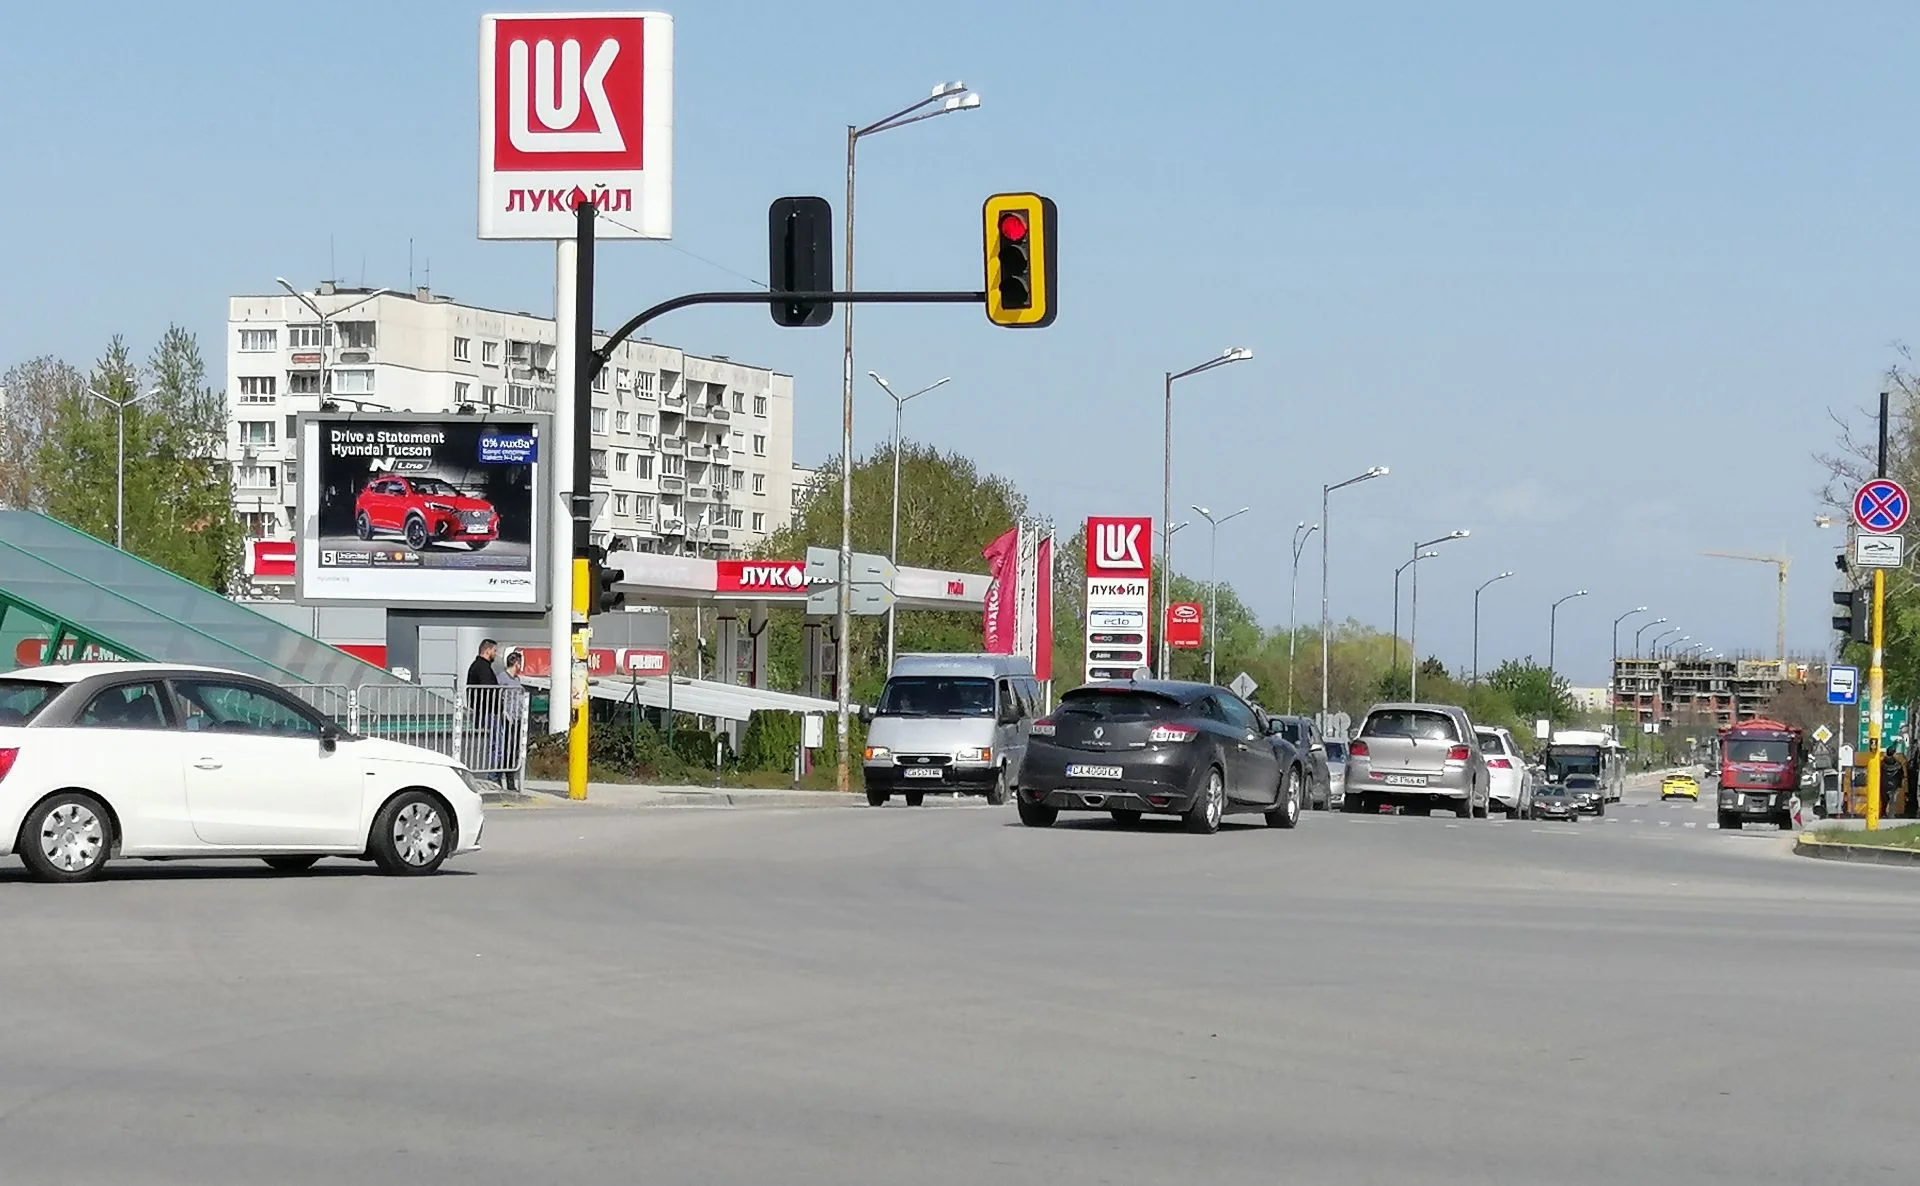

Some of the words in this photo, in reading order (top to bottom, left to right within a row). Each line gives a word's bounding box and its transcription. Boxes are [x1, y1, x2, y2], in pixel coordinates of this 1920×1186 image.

[331, 429, 364, 443] Drive
[366, 432, 375, 443] a
[377, 431, 445, 444] Statement
[482, 438, 498, 448] 0%
[331, 443, 384, 458] Hyundai
[386, 444, 432, 456] Tucson
[324, 552, 332, 563] 5
[1090, 584, 1145, 596] ЛУКОЙЛ
